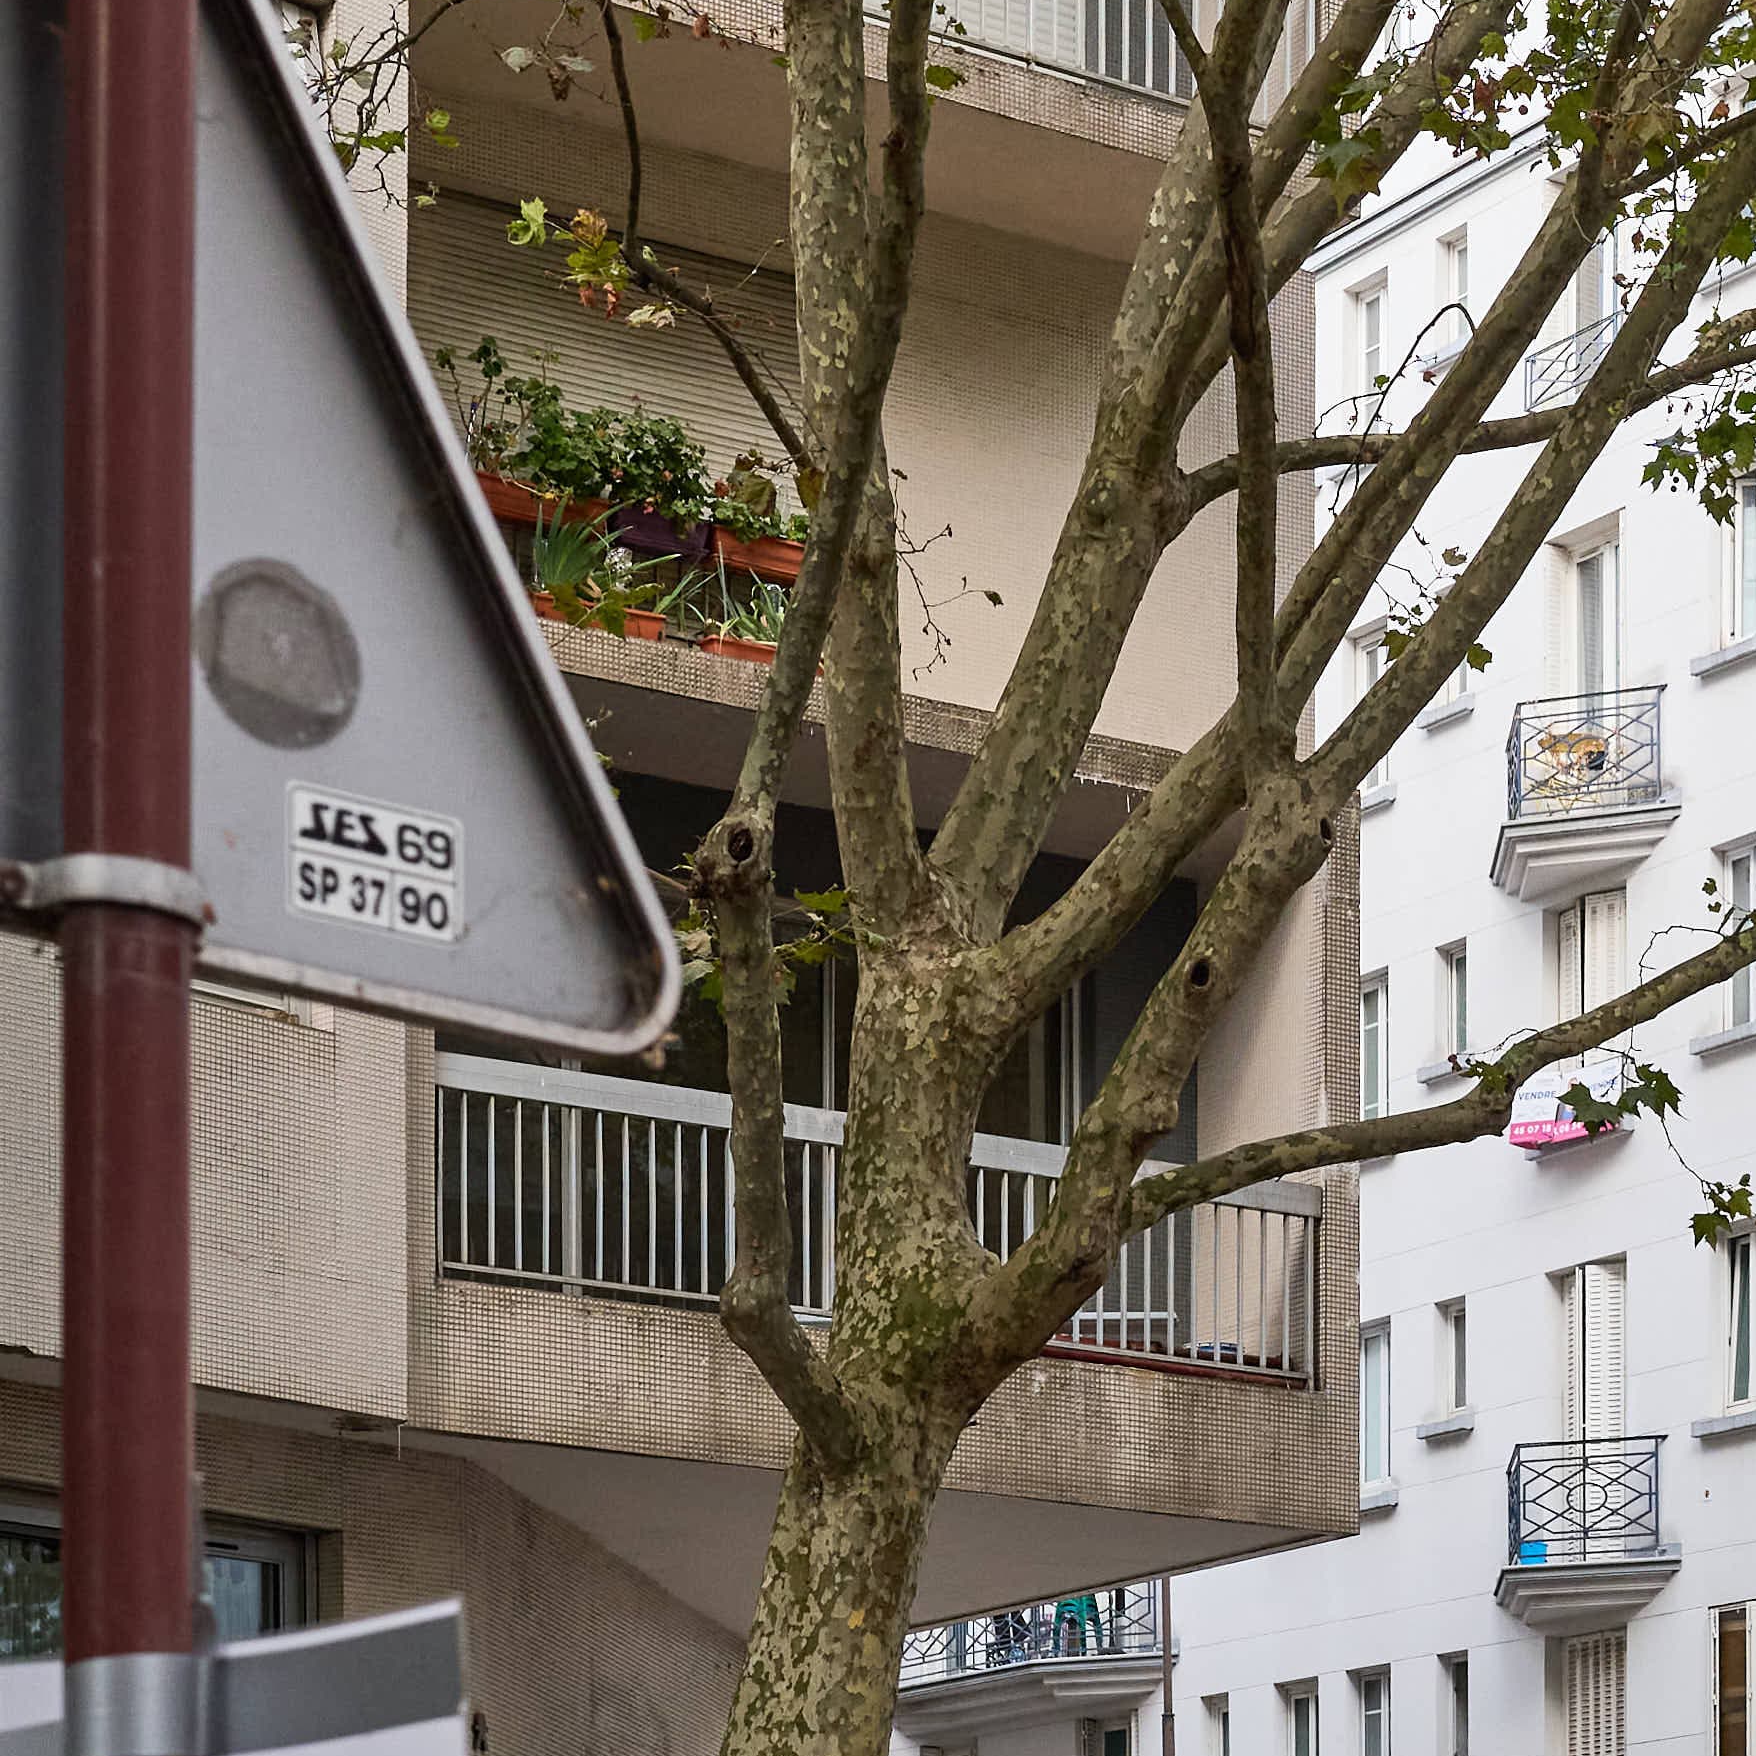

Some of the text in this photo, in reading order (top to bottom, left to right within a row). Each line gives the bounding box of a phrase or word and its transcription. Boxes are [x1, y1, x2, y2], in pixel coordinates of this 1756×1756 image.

[397, 823, 451, 870] 69
[299, 861, 448, 930] SP 37 90
